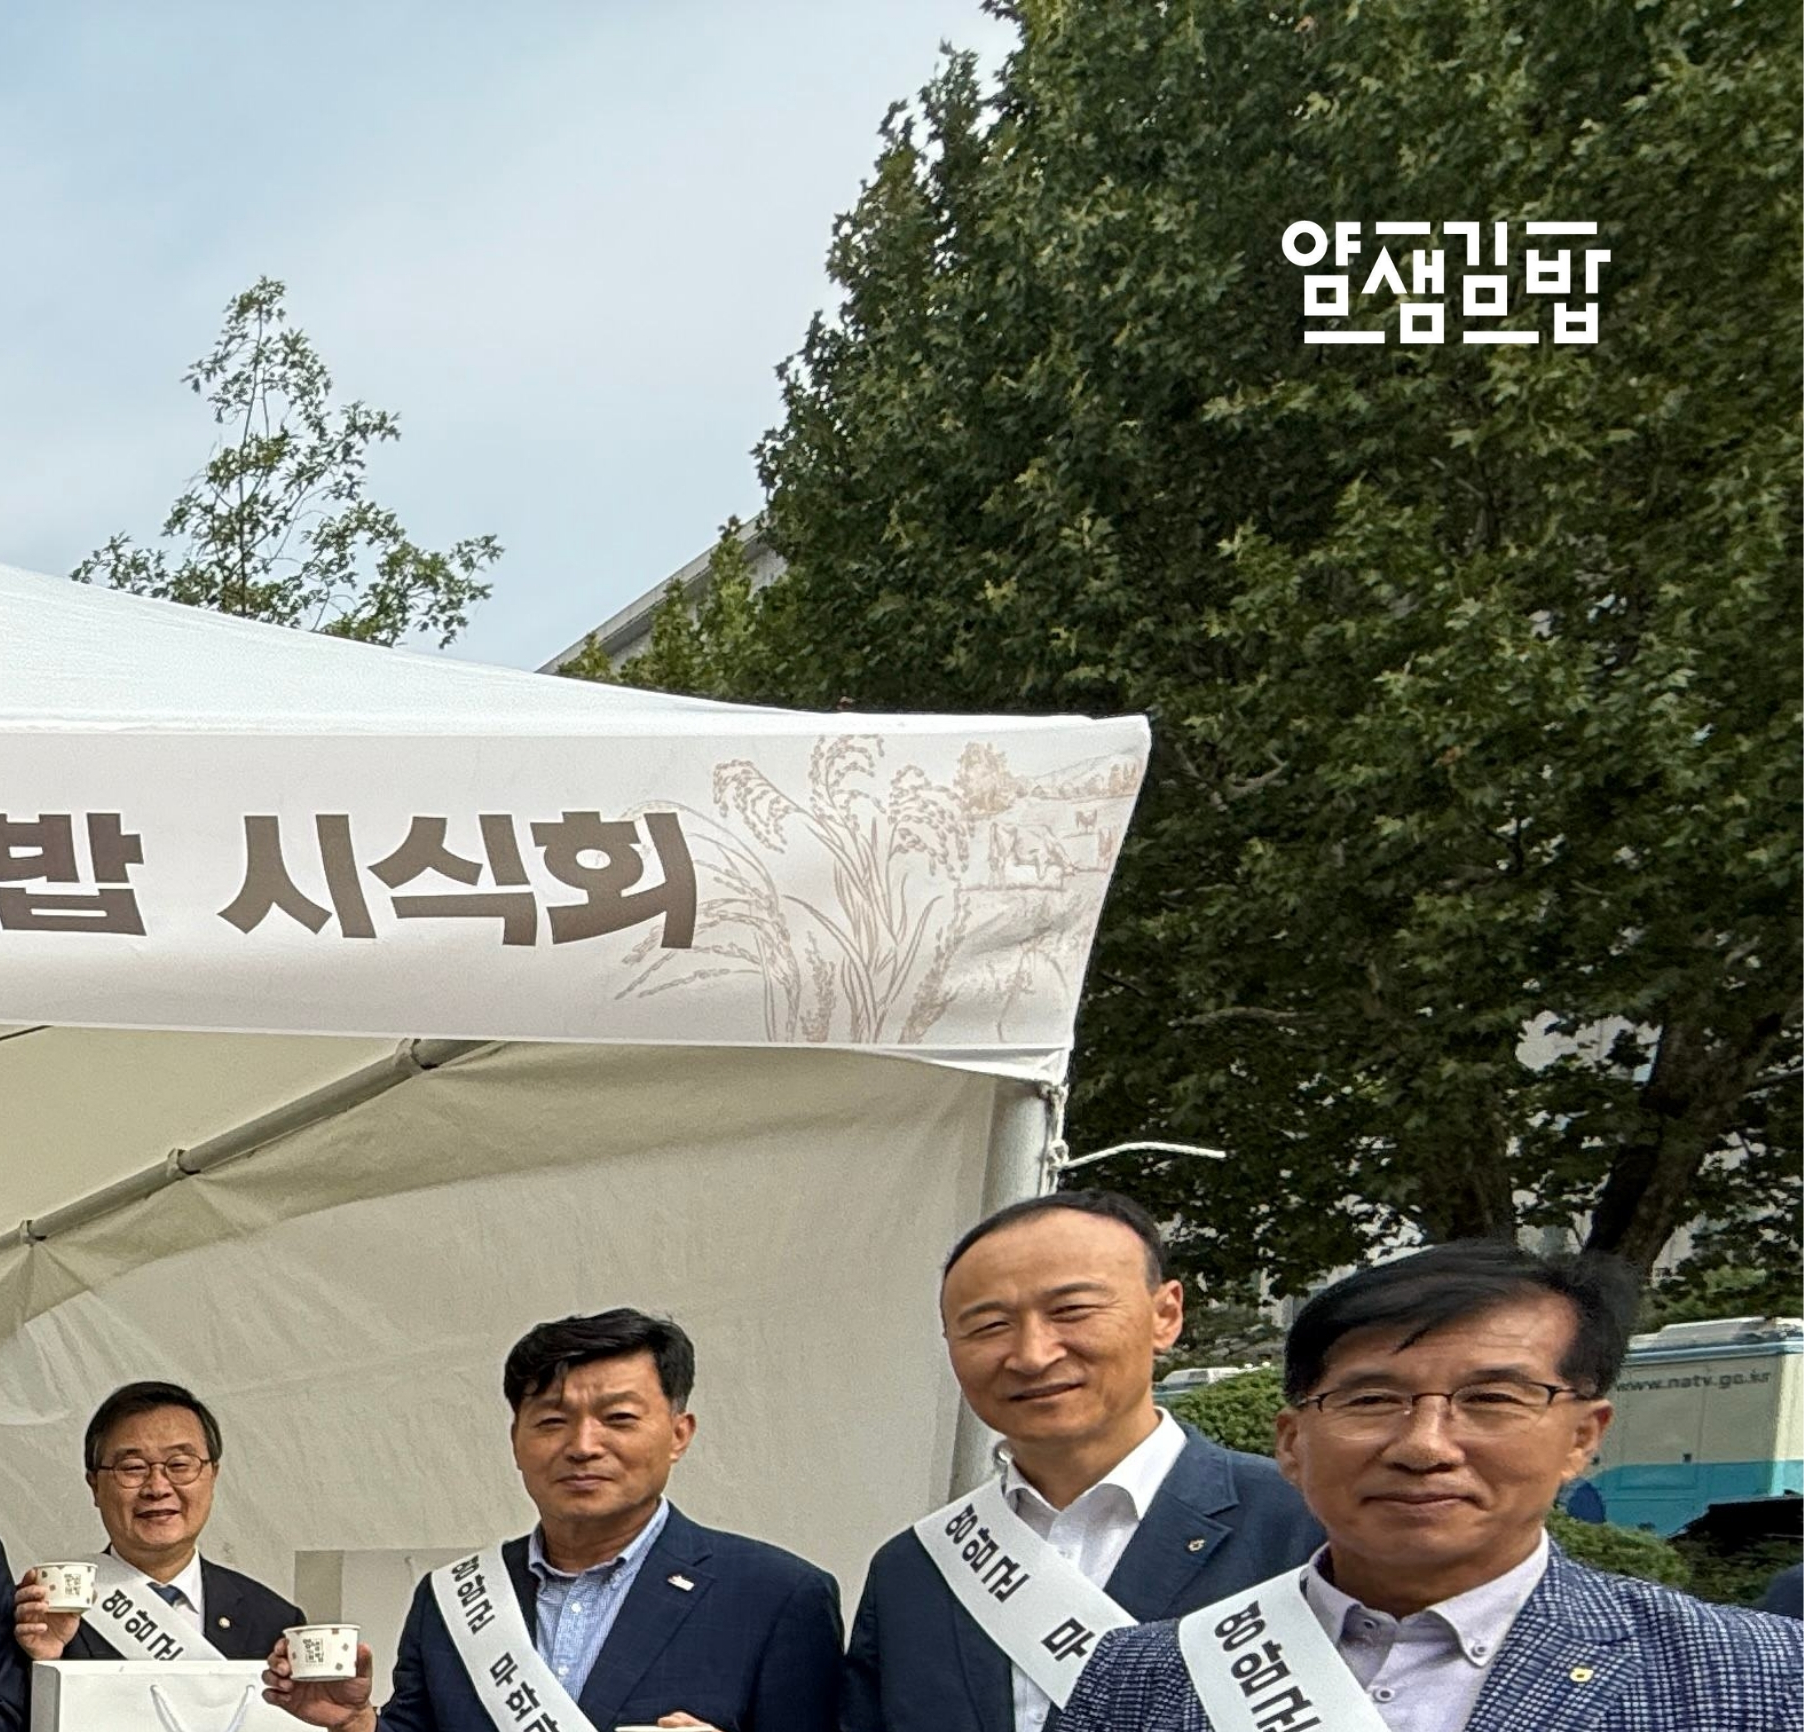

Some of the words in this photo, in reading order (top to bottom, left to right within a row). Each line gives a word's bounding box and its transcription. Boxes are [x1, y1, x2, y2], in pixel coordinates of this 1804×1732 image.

[218, 809, 697, 951] 시식회
[452, 1555, 496, 1636] 영암군
[944, 1505, 1031, 1603] 영암군
[101, 1588, 184, 1661] 영암군
